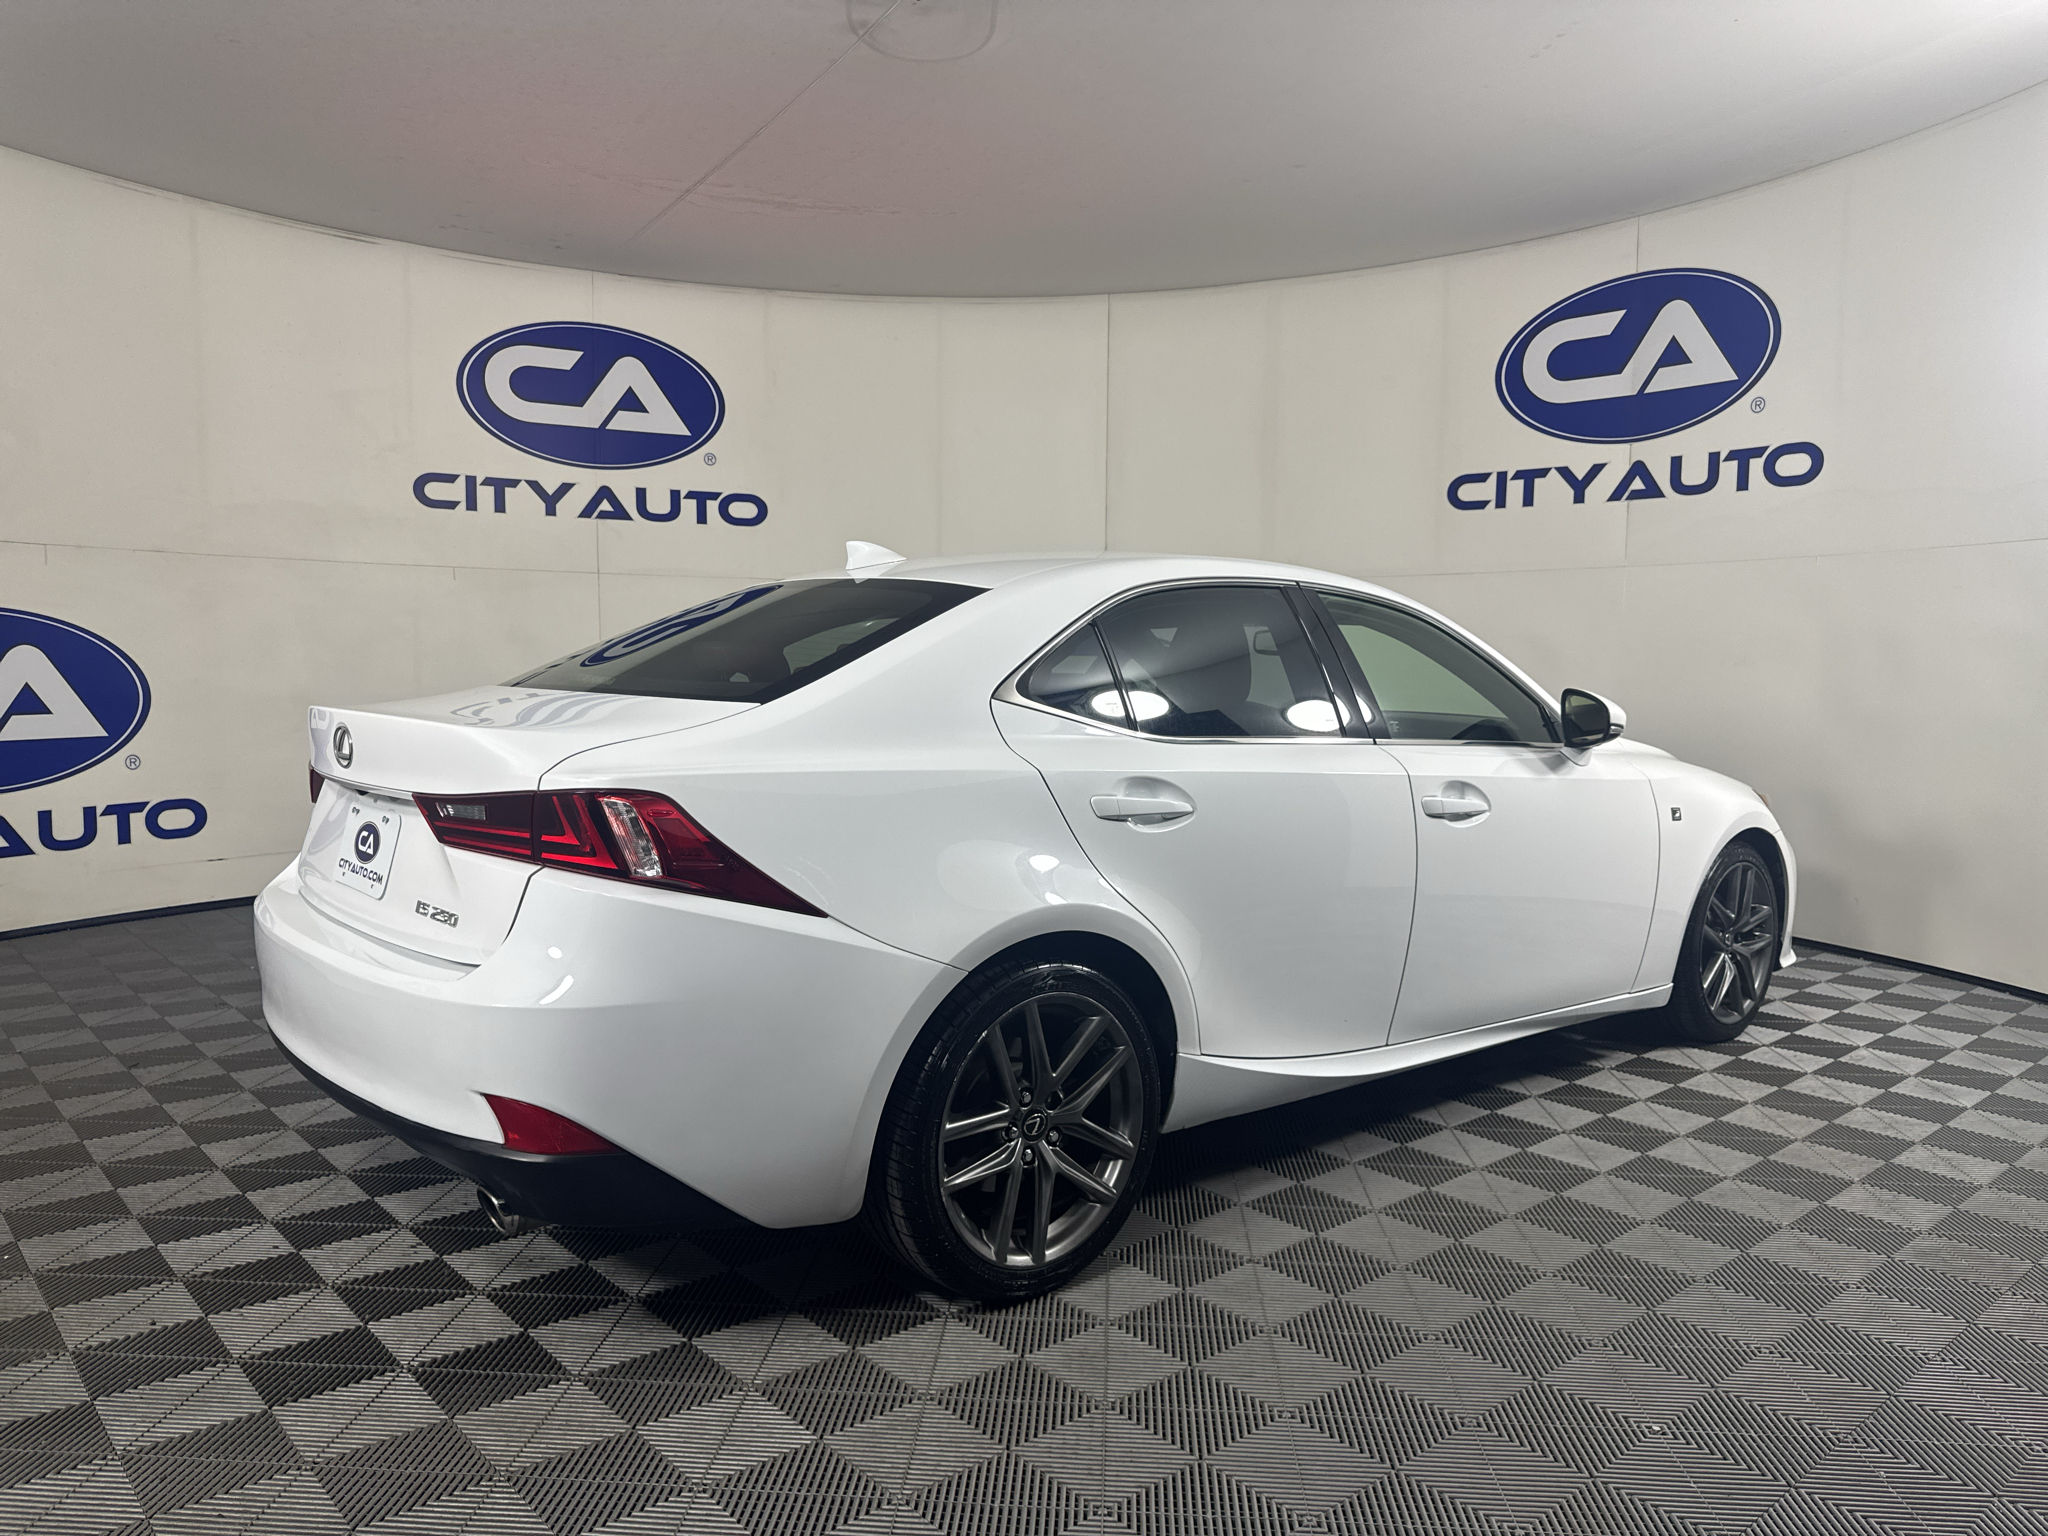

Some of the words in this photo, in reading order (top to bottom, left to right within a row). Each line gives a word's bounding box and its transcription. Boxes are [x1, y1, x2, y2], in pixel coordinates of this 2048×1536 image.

[1522, 299, 1739, 404] CA
[484, 345, 692, 436] CA
[412, 472, 577, 517] CITY
[577, 485, 768, 527] AUTO
[1447, 462, 1609, 511] CITY
[1605, 441, 1825, 502] AUTO
[358, 830, 374, 855] CA
